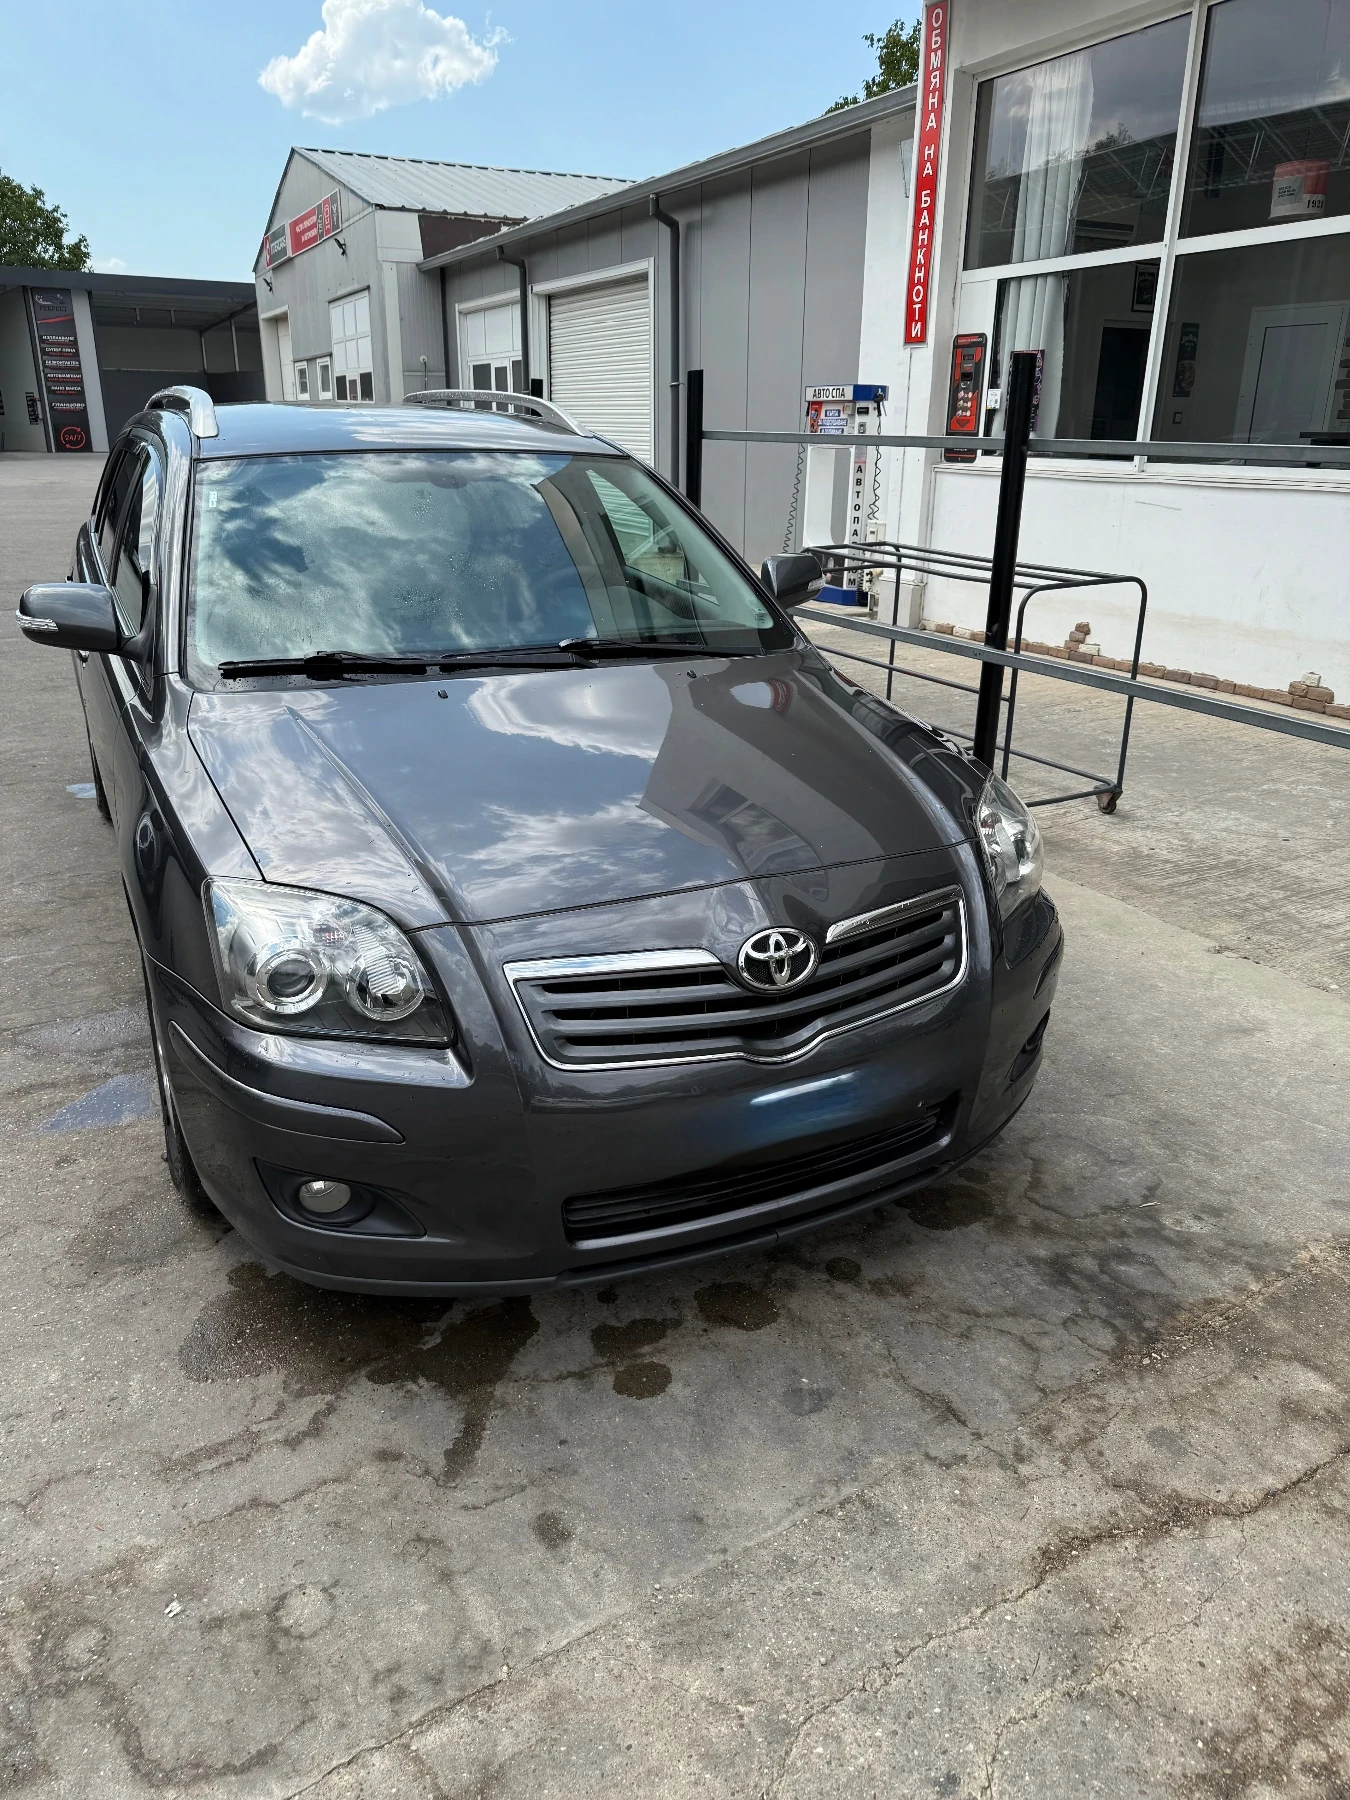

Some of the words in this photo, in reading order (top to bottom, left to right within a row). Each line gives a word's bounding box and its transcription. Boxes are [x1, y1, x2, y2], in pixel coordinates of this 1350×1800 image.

[926, 7, 943, 132] ОБМЯНА
[922, 144, 935, 177] НА
[911, 190, 931, 338] БАНКНОТИ
[812, 388, 830, 399] АВТО
[831, 388, 846, 399] СПА
[848, 465, 863, 586] АВТОПАЮМ
